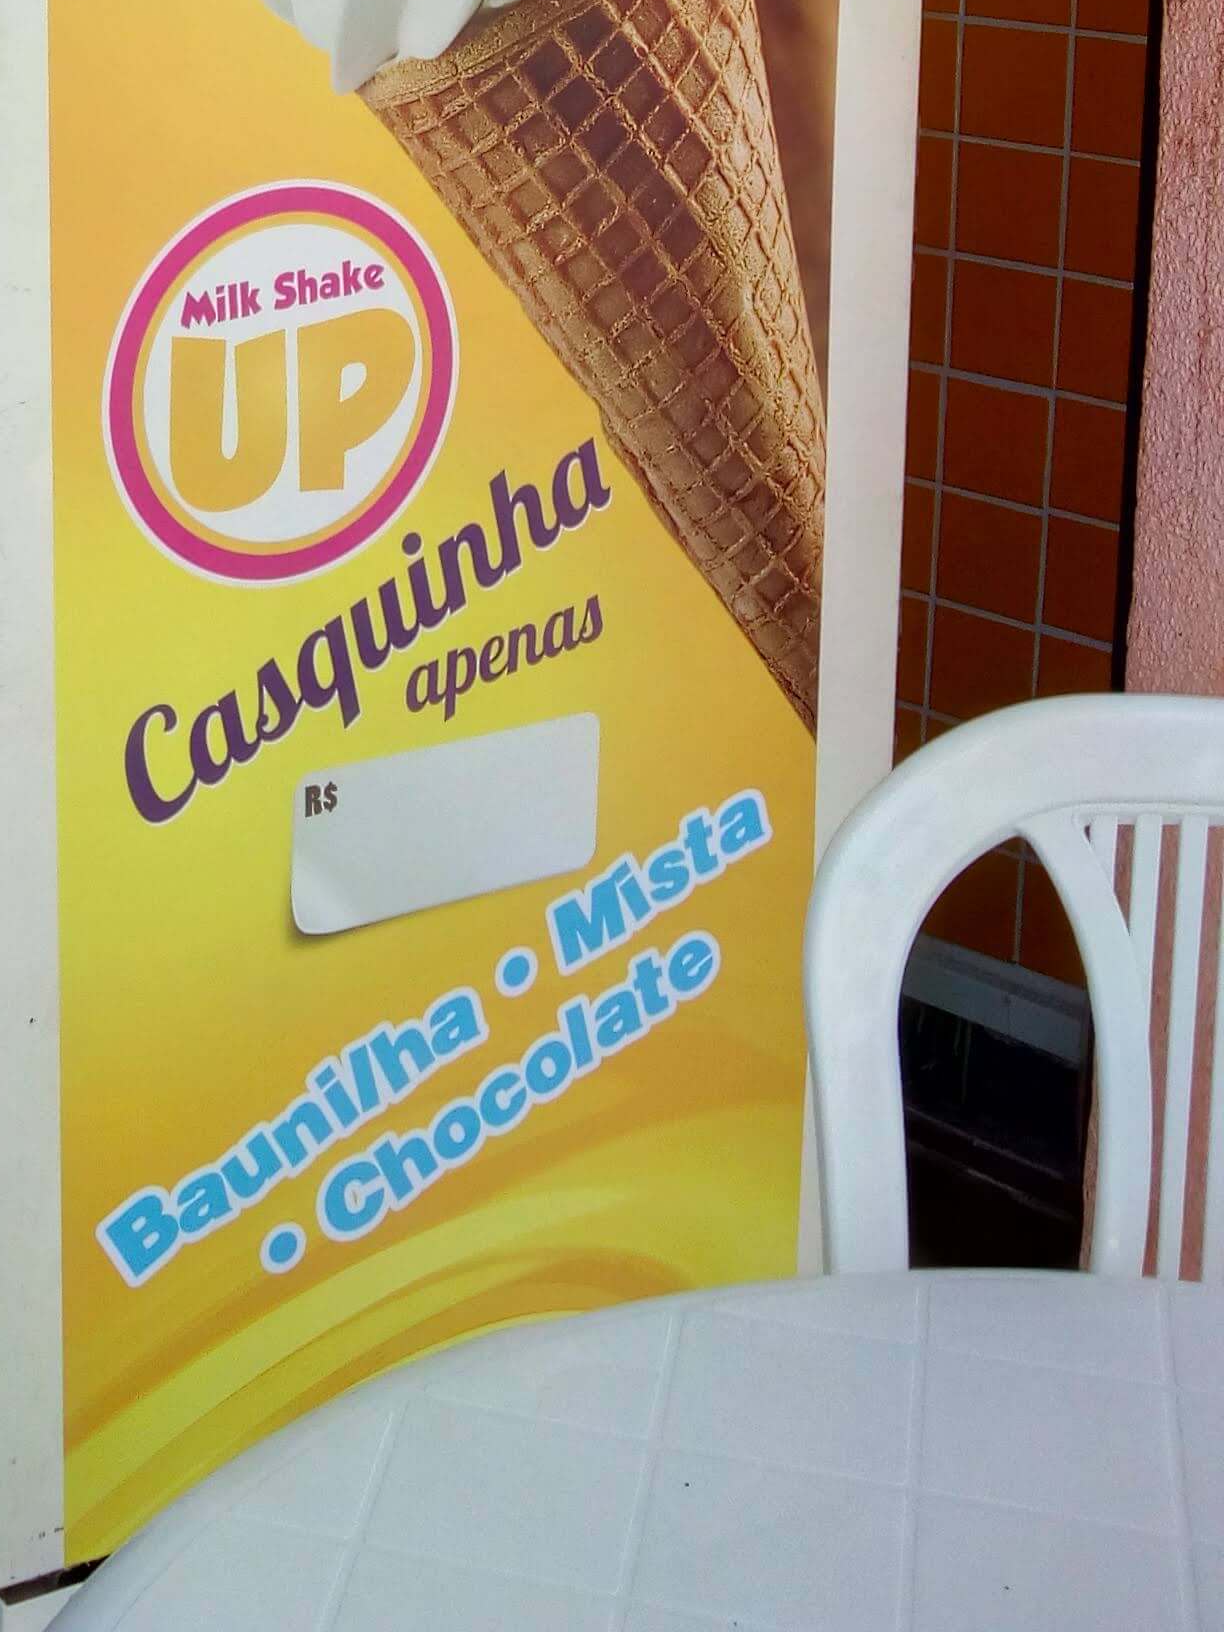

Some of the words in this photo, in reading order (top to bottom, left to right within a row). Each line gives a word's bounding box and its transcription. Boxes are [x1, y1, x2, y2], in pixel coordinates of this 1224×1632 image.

[180, 284, 262, 329] Milk
[274, 259, 386, 311] Shake
[170, 307, 416, 513] UP
[124, 437, 612, 825] Casquinha
[405, 594, 604, 723] apenas
[304, 781, 339, 818] R$
[101, 990, 485, 1279] Baunilha
[552, 794, 766, 969] Mista
[322, 936, 715, 1236] Chocolate
